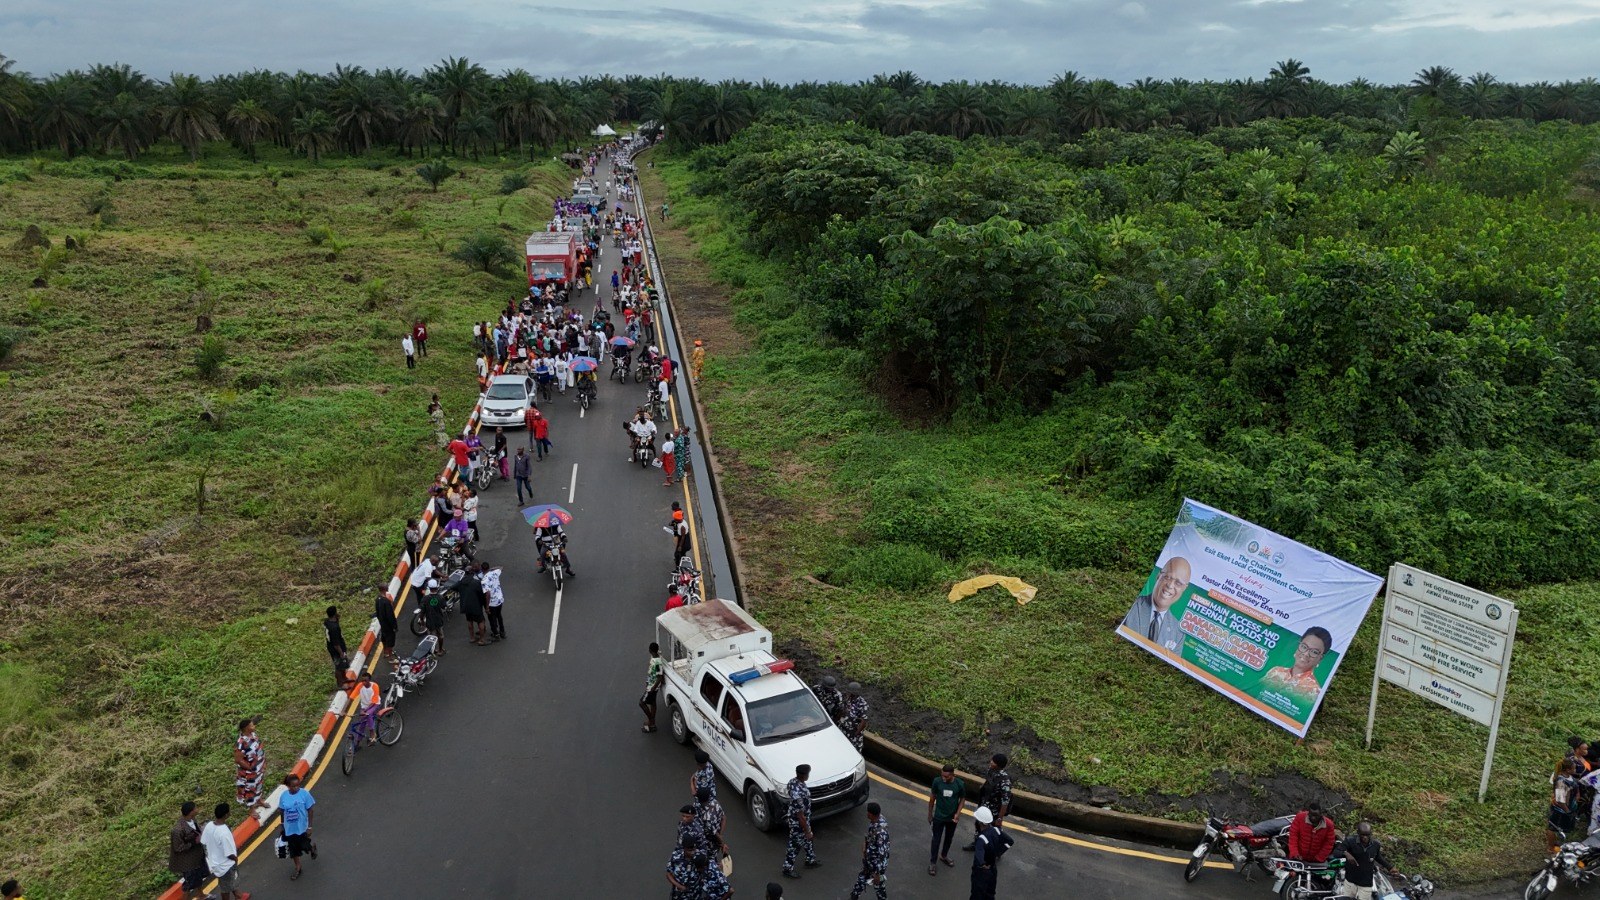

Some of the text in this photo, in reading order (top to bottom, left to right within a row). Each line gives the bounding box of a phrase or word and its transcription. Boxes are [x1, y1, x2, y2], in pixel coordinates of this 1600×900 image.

[1204, 545, 1313, 598] Esit Eket Local Government Council
[1237, 554, 1250, 563] The
[1249, 559, 1282, 577] Chairman
[1201, 574, 1221, 587] Pastor
[1235, 590, 1259, 607] Bassey
[1259, 602, 1275, 614] Eno,
[1274, 608, 1290, 620] PhD
[1224, 578, 1270, 605] His Excellency
[1426, 588, 1473, 610] AKWA IBOM STATE
[1433, 584, 1470, 602] GOVERNMENT
[1186, 599, 1229, 625] INTERNAL
[1229, 620, 1262, 642] ROADS
[1261, 636, 1276, 649] TO
[1208, 602, 1280, 641] MAIN ACCESS AND
[1196, 627, 1224, 647] PALM
[1223, 642, 1263, 668] LIMITED
[1228, 633, 1267, 659] GLOBAL
[1420, 643, 1448, 659] MINISTRY
[1460, 660, 1483, 673] WORKS
[1422, 652, 1475, 678] AND FIRE SERVICE
[1419, 684, 1474, 713] JEOSHKAY LIMITED
[702, 720, 726, 750] POLICE
